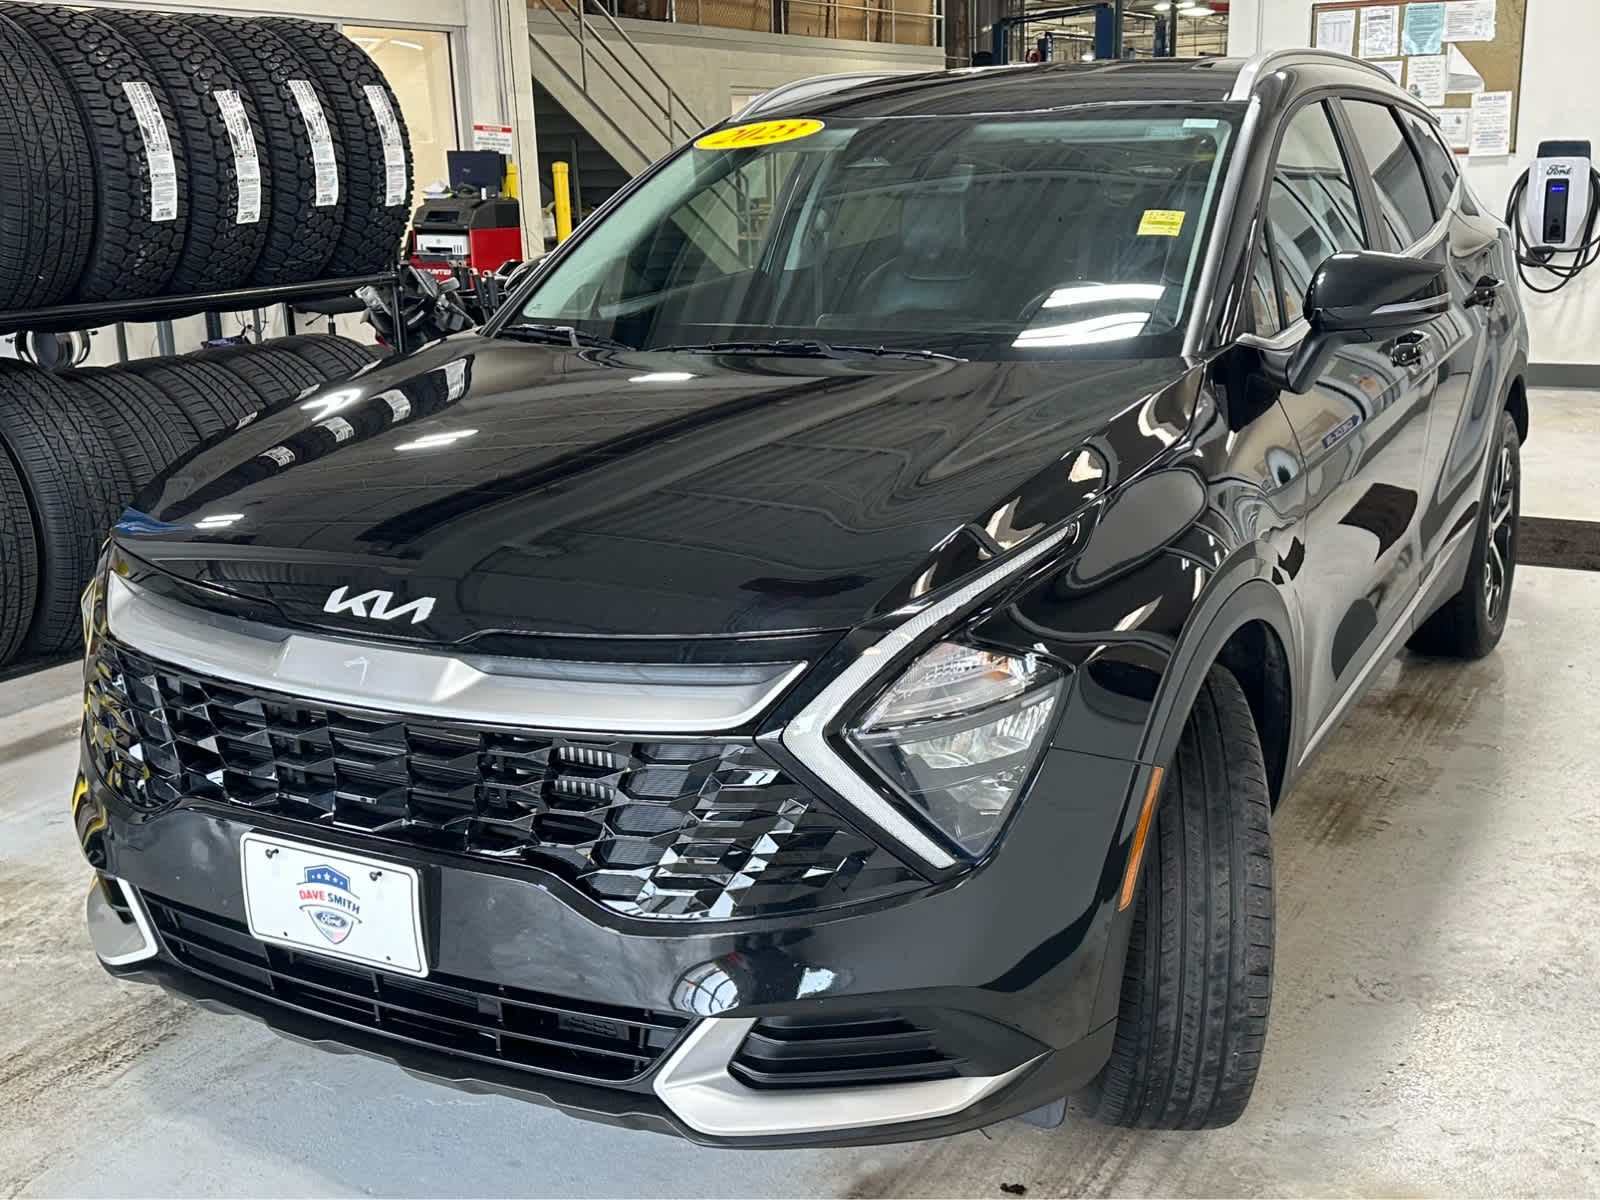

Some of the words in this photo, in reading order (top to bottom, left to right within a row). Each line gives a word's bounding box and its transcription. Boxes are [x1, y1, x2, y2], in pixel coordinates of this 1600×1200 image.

[711, 122, 808, 145] 2023
[1546, 164, 1572, 175] Ford
[299, 889, 326, 901] DAVE
[327, 892, 360, 914] SMITH
